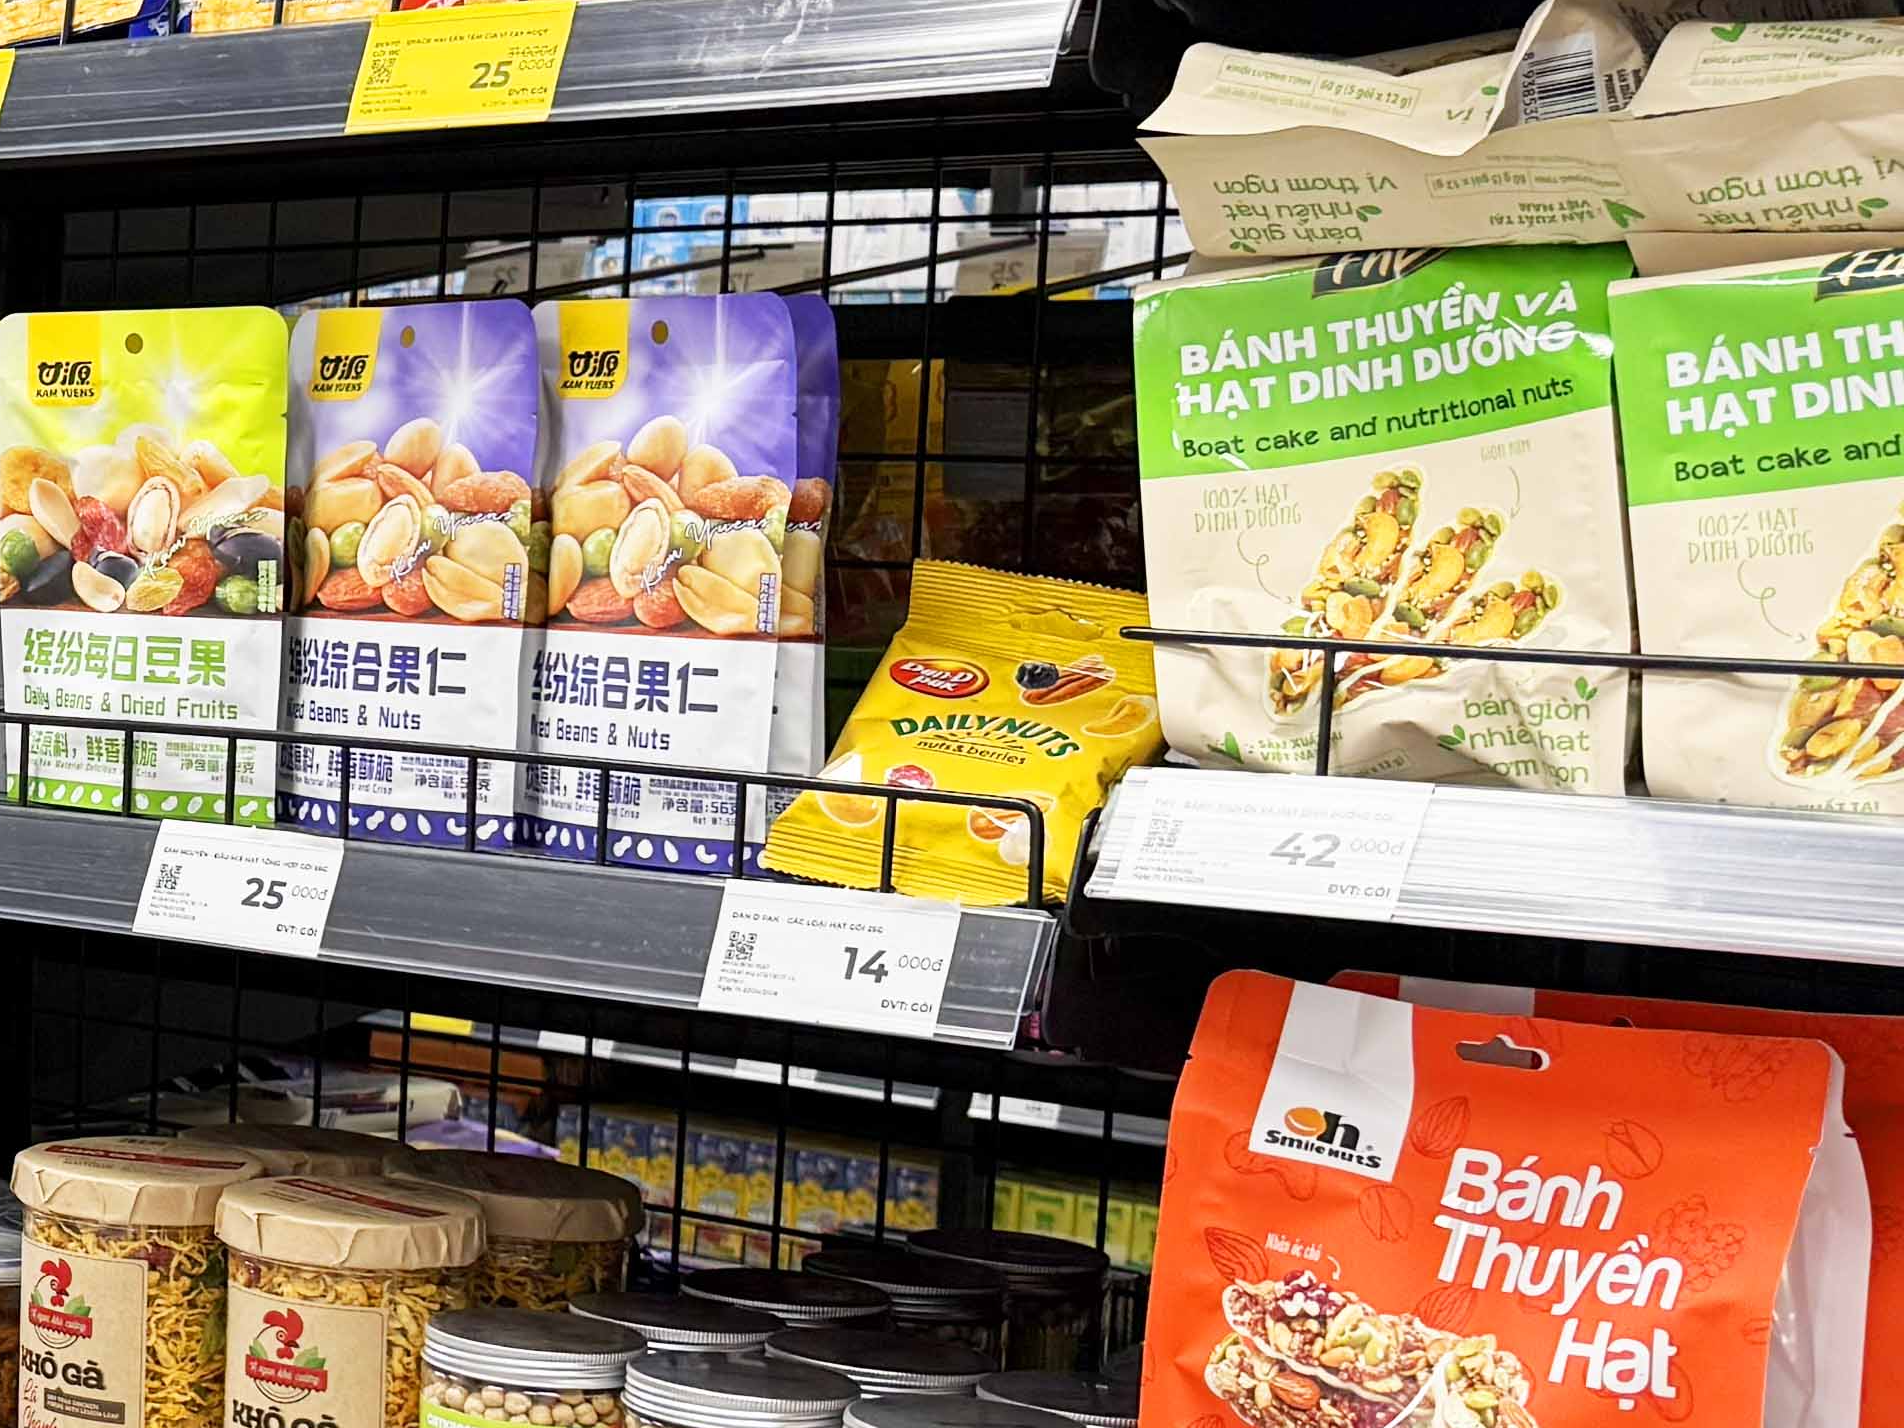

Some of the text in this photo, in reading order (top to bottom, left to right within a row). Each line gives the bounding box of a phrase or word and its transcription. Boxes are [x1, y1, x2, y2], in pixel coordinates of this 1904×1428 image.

[469, 60, 512, 90] 25
[1180, 279, 1577, 376] BÁNH THUYỀN VÀ
[1178, 319, 1576, 419] HẠT DINH DƯỠNG
[1665, 334, 1825, 387] BÁNH
[1182, 376, 1574, 459] Boat cake and nutritional nuts
[24, 628, 227, 687] 缤纷每日豆果
[24, 686, 239, 720] Daily Beans Dried Fruits
[310, 703, 421, 729] Beans Nuts
[1269, 832, 1341, 868] 42
[241, 878, 286, 909] 25
[844, 946, 889, 983] 14
[1440, 1146, 1624, 1232] Bánh
[1435, 1213, 1685, 1318] Thuyền
[1548, 1318, 1679, 1413] Hạt
